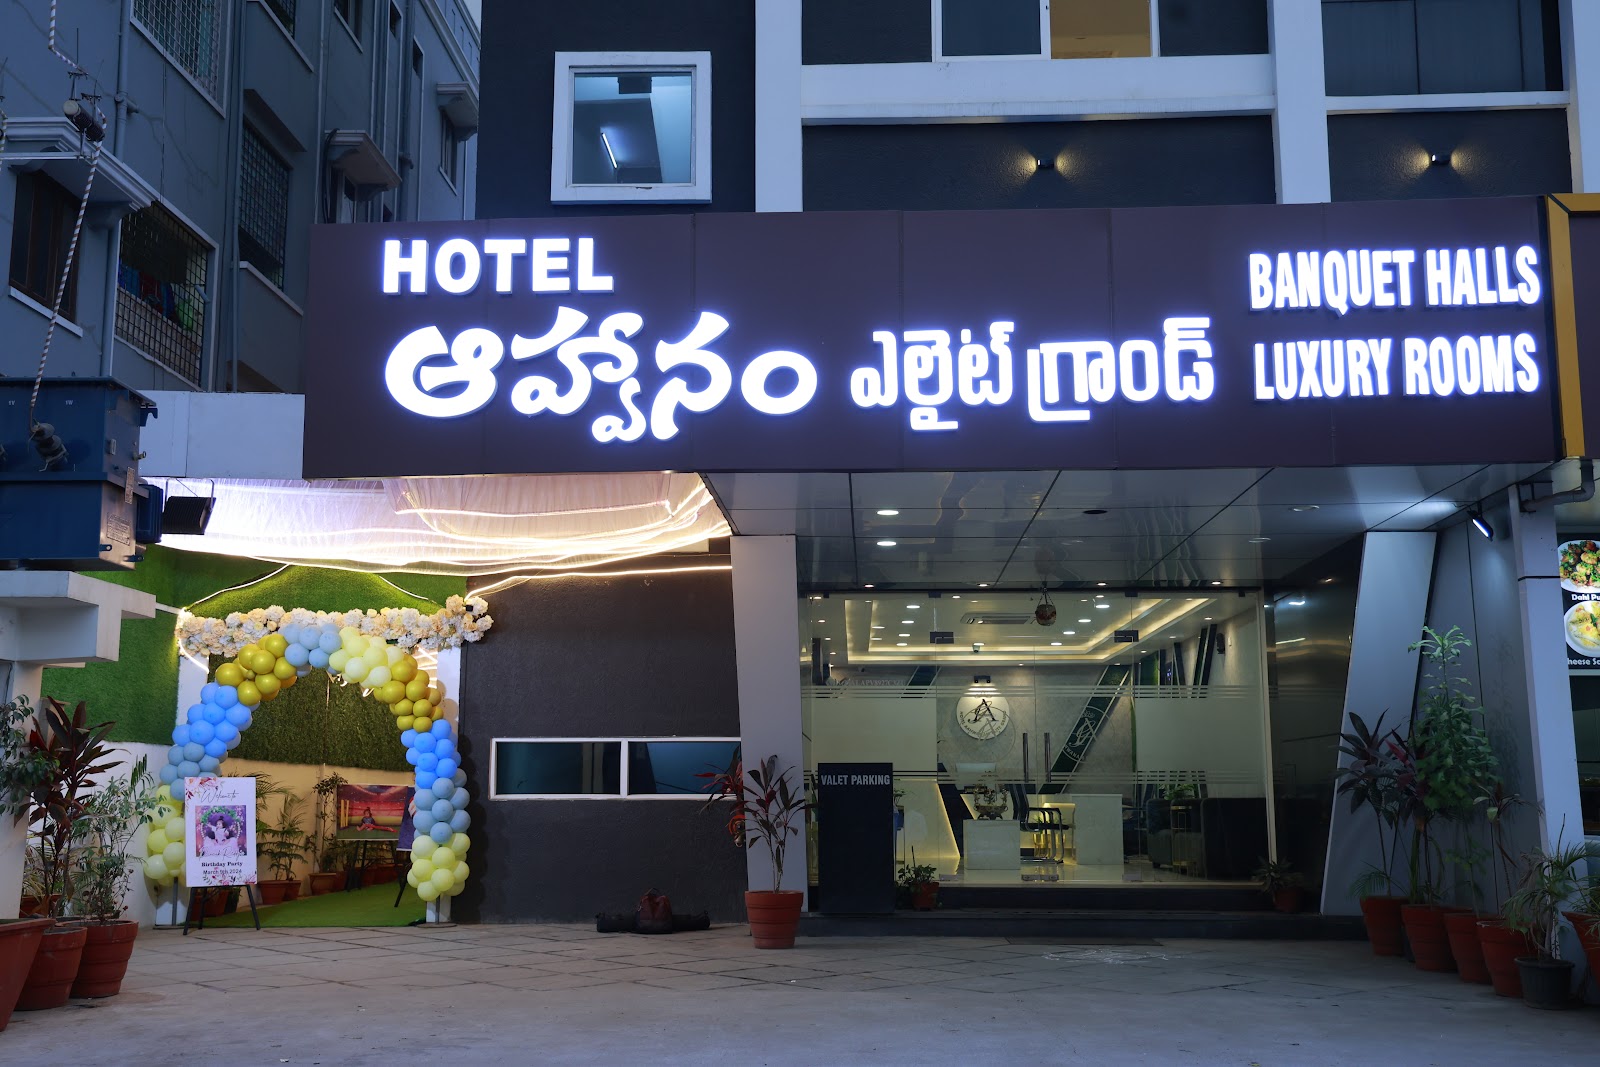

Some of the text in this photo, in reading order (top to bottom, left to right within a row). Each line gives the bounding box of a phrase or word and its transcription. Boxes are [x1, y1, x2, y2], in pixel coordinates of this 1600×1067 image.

[383, 238, 614, 294] HOTEL
[1249, 245, 1541, 315] BANQUET HALLS
[385, 305, 1215, 443] ఆహ్వానం ఎలైట్ గ్రాండ్
[1254, 333, 1540, 400] LUXURY ROOMS
[1571, 593, 1590, 601] Dahl
[1567, 657, 1591, 666] heese
[820, 774, 891, 785] VALET PARKING
